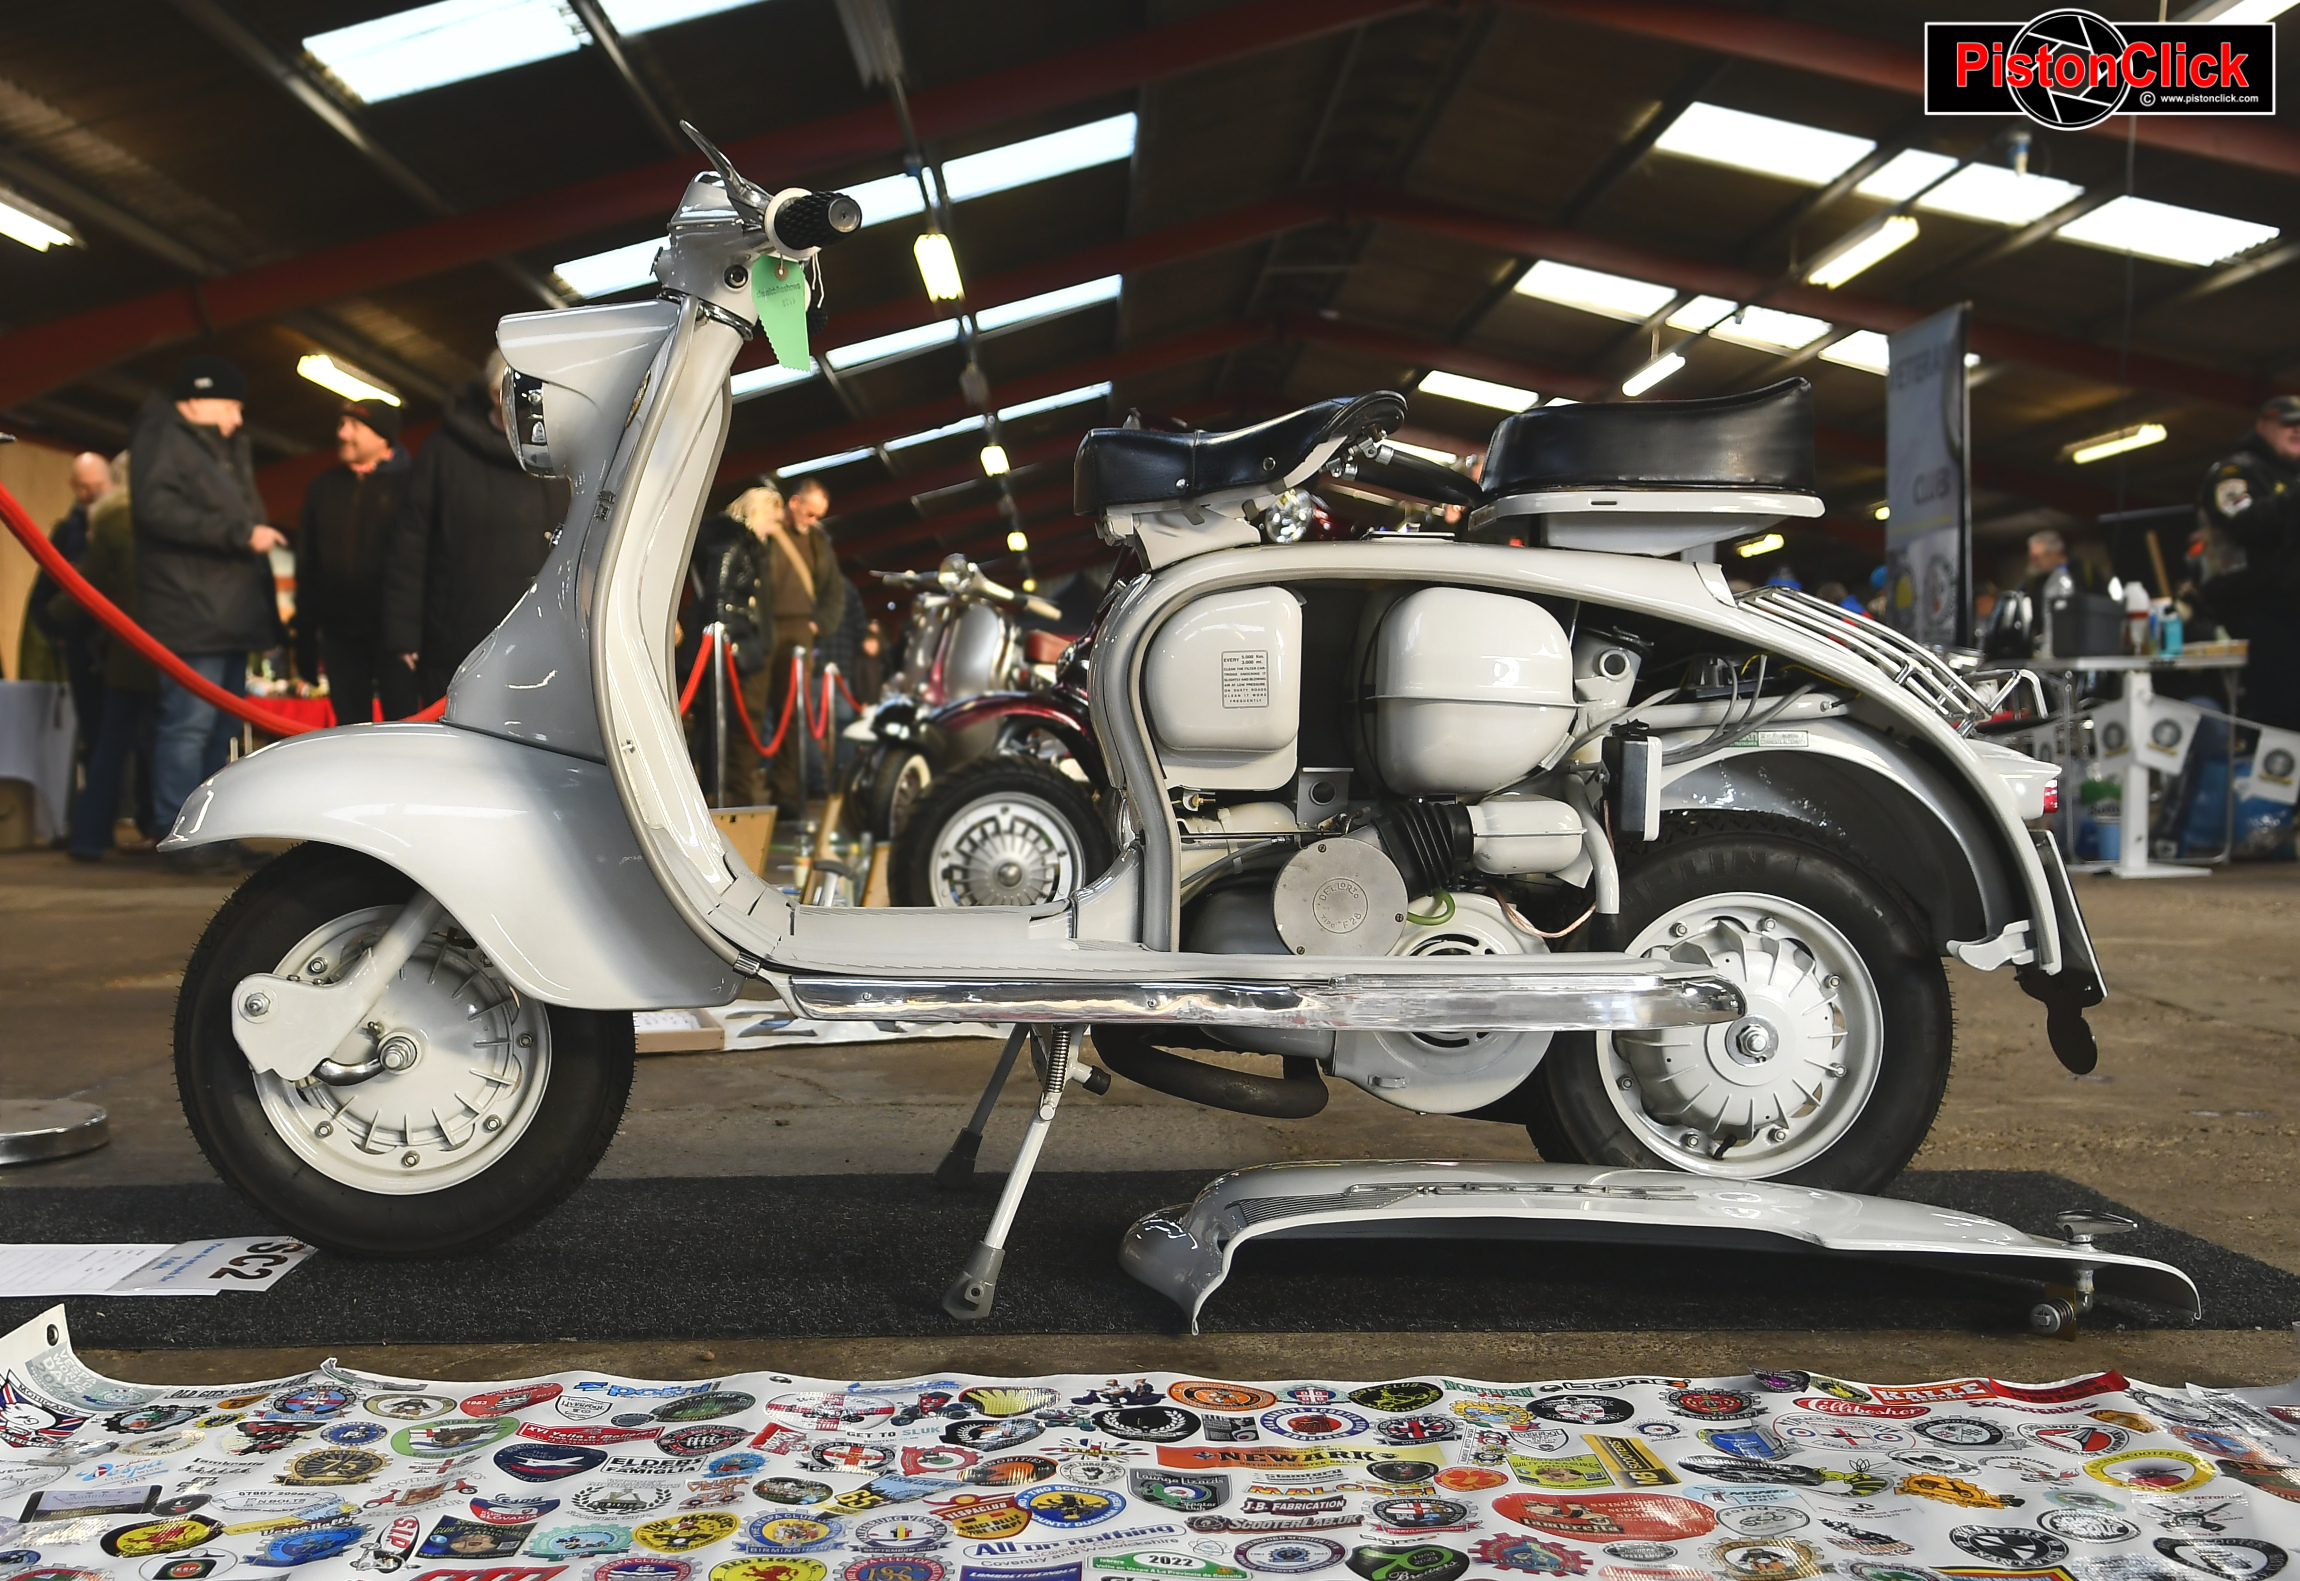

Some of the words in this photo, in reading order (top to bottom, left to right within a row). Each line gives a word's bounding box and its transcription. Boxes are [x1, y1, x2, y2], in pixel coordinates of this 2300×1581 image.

[53, 1353, 93, 1389] WORLD
[61, 1349, 97, 1385] VESPA
[44, 1357, 87, 1393] DAYS
[1442, 1379, 1536, 1398] NORTHERN
[19, 1385, 76, 1414] MOHICANS
[1967, 1400, 2099, 1415] SCOOTERING
[902, 1427, 941, 1436] SLUK
[611, 1457, 704, 1466] ELDERS
[1218, 1450, 1378, 1462] NEWARK
[321, 1458, 362, 1471] 75
[605, 1466, 696, 1475] FAMIGLIA
[1136, 1470, 1179, 1484] Lounge
[1181, 1474, 1224, 1485] Lizards
[1054, 1485, 1107, 1496] SCOOTER
[1248, 1484, 1437, 1497] MALOSSI
[836, 1489, 885, 1509] 65
[1243, 1501, 1268, 1511] J.B.
[1271, 1500, 1345, 1511] FABRICATION
[480, 1513, 538, 1521] SLOVAKIA
[945, 1502, 1008, 1519] VESPACLUB
[1074, 1508, 1117, 1527] DURHAM
[1522, 1518, 1621, 1532] Lambretta
[386, 1518, 418, 1551] SIP
[750, 1545, 828, 1553] BIRMINGHAM
[975, 1540, 1018, 1556] All
[981, 1557, 1047, 1567] Coventry
[1052, 1550, 1079, 1559] and
[1082, 1538, 1180, 1553] Warwickshire
[1034, 1544, 1086, 1558] Scooter
[1092, 1540, 1126, 1549] Club
[720, 1558, 752, 1570] RED
[1149, 1555, 1194, 1567] 2022
